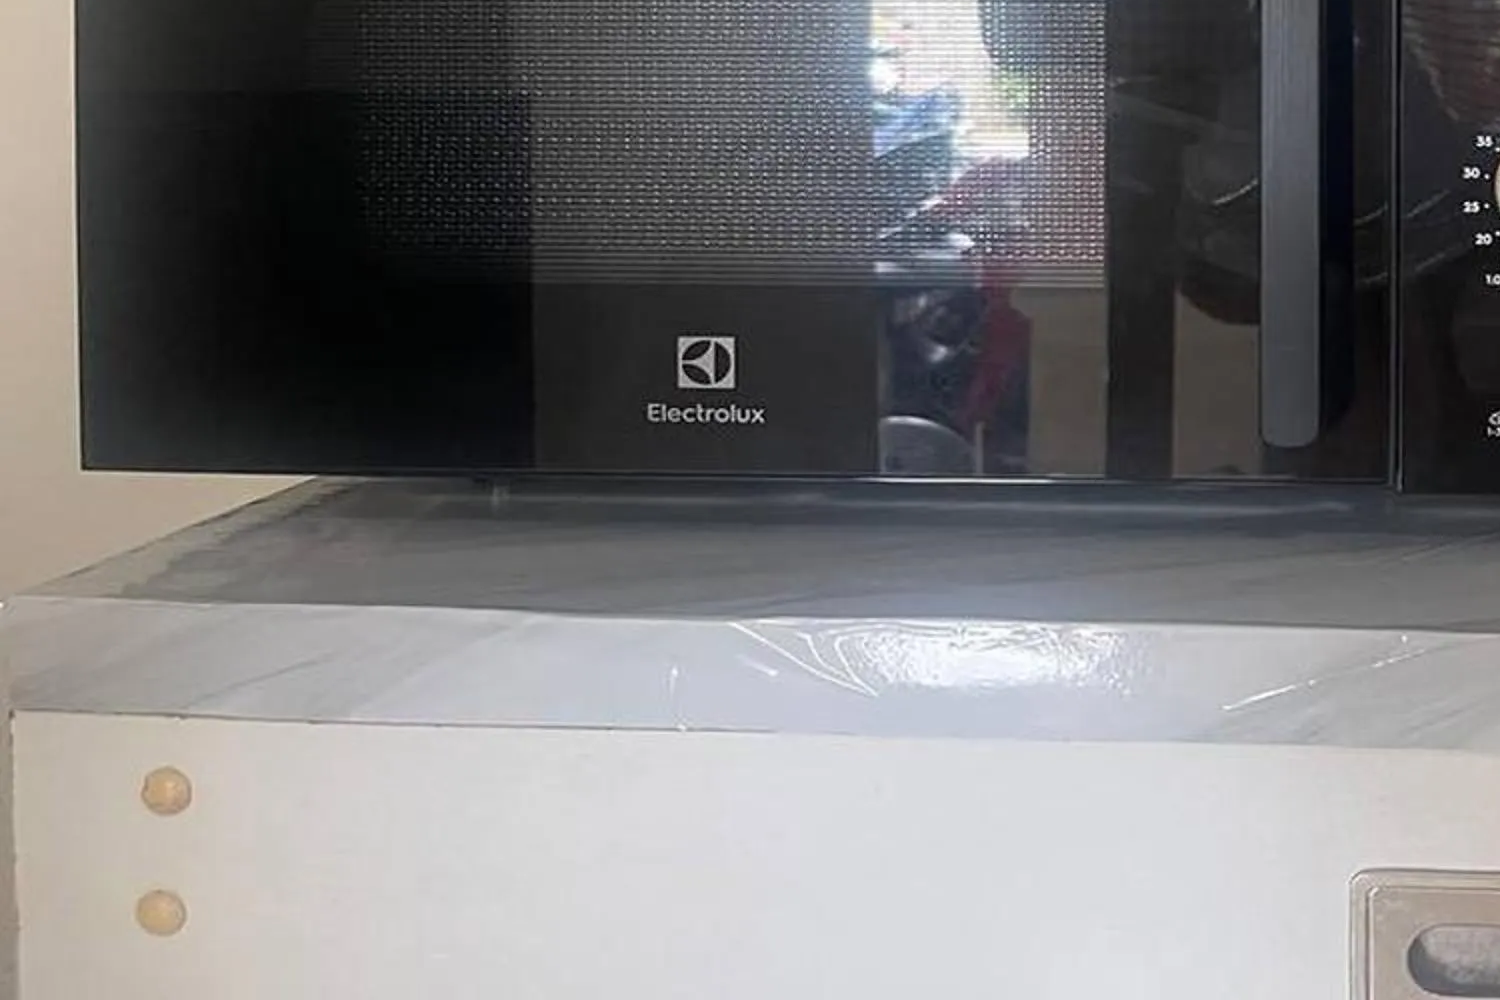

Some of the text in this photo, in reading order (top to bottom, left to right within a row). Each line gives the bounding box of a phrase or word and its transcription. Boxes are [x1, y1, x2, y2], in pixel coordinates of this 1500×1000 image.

[1476, 135, 1493, 148] 35
[1463, 167, 1481, 179] 30
[1463, 201, 1480, 213] 25
[1475, 233, 1493, 246] 20
[647, 403, 766, 424] Electrolux
